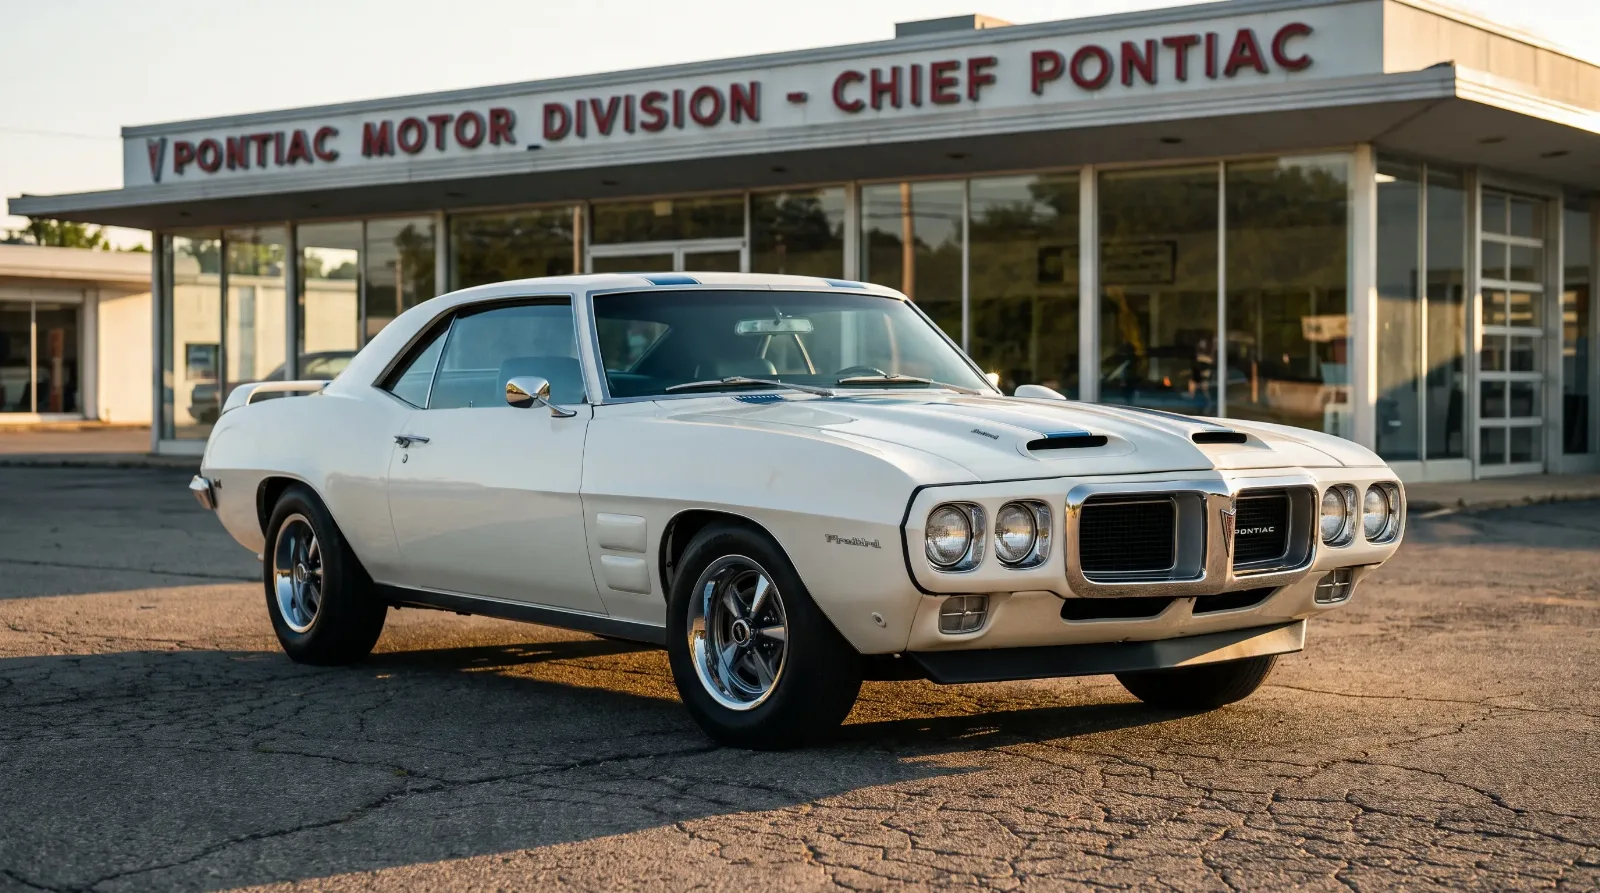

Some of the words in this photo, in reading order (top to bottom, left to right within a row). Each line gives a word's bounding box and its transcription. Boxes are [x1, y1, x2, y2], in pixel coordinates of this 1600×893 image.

[173, 126, 340, 175] PONTIAC
[362, 107, 517, 159] MOTOR
[543, 81, 762, 141] DIVISION
[832, 56, 998, 115] CHIEF
[1031, 22, 1313, 96] PONTIAC
[1235, 526, 1275, 535] PONTIAC
